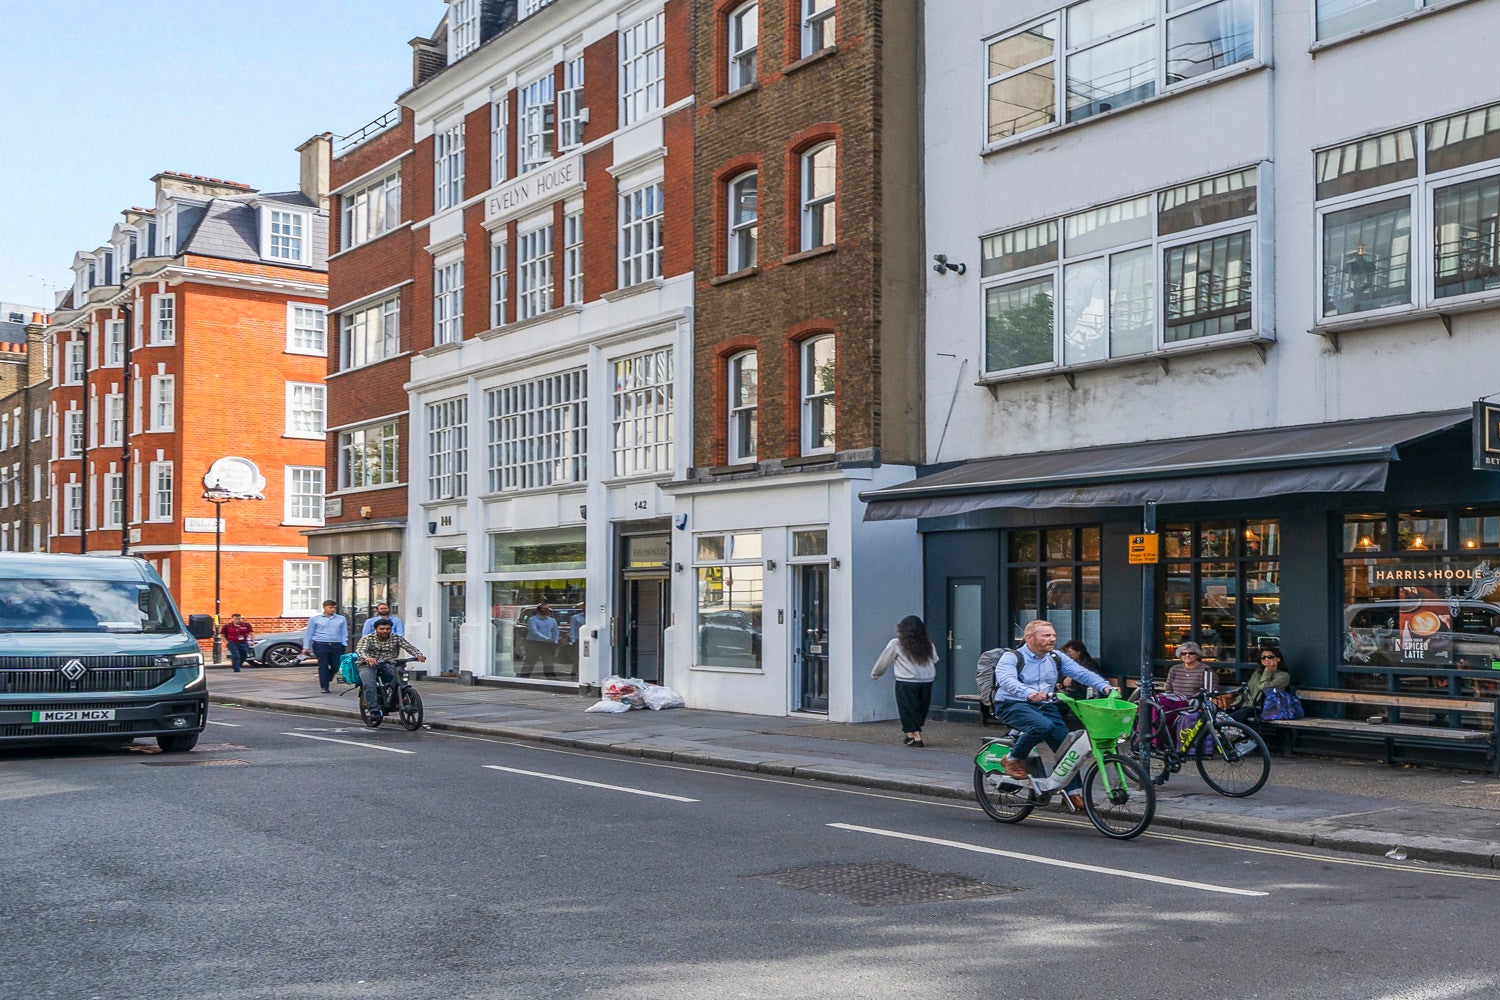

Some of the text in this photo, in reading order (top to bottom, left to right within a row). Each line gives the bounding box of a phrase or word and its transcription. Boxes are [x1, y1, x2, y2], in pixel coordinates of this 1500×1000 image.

[490, 163, 573, 215] EVELYN HOUSE
[634, 500, 648, 510] 142
[1376, 569, 1483, 580] HARRIS+HOOLE
[1404, 642, 1429, 651] SPICED
[1404, 650, 1425, 659] LATTE
[44, 710, 110, 721] MG21 MGX
